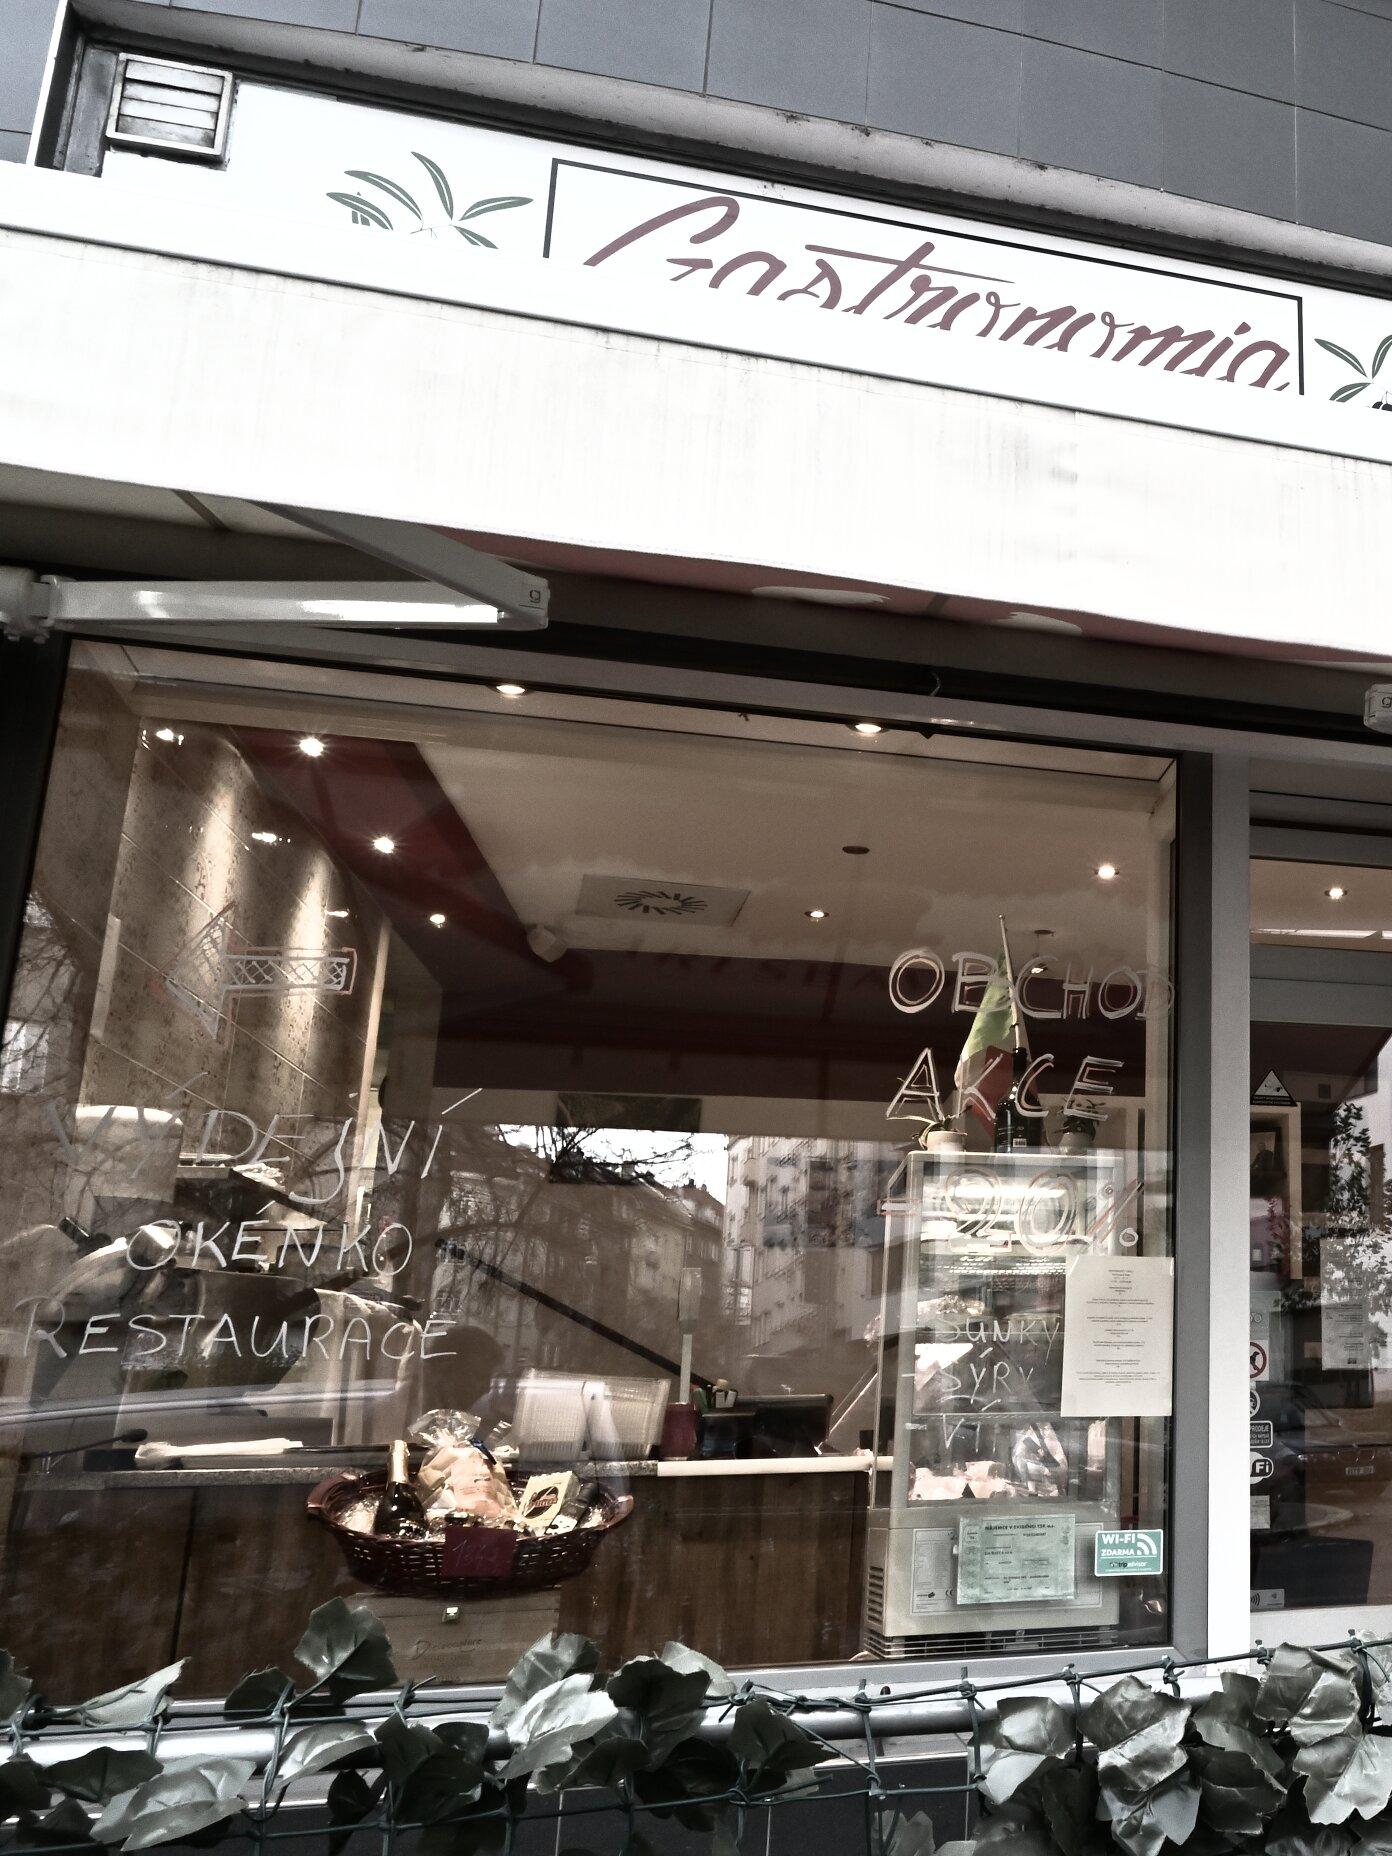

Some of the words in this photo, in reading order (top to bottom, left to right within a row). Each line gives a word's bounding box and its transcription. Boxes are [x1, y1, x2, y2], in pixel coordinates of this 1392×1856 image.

[582, 195, 1290, 392] Gastronomia
[888, 947, 1176, 1021] OBCHOD
[885, 1047, 1125, 1123] AKCE
[15, 1295, 458, 1361] RESTAURACE
[1100, 1548, 1135, 1557] ZDARMA
[1101, 1533, 1136, 1545] WI-FI
